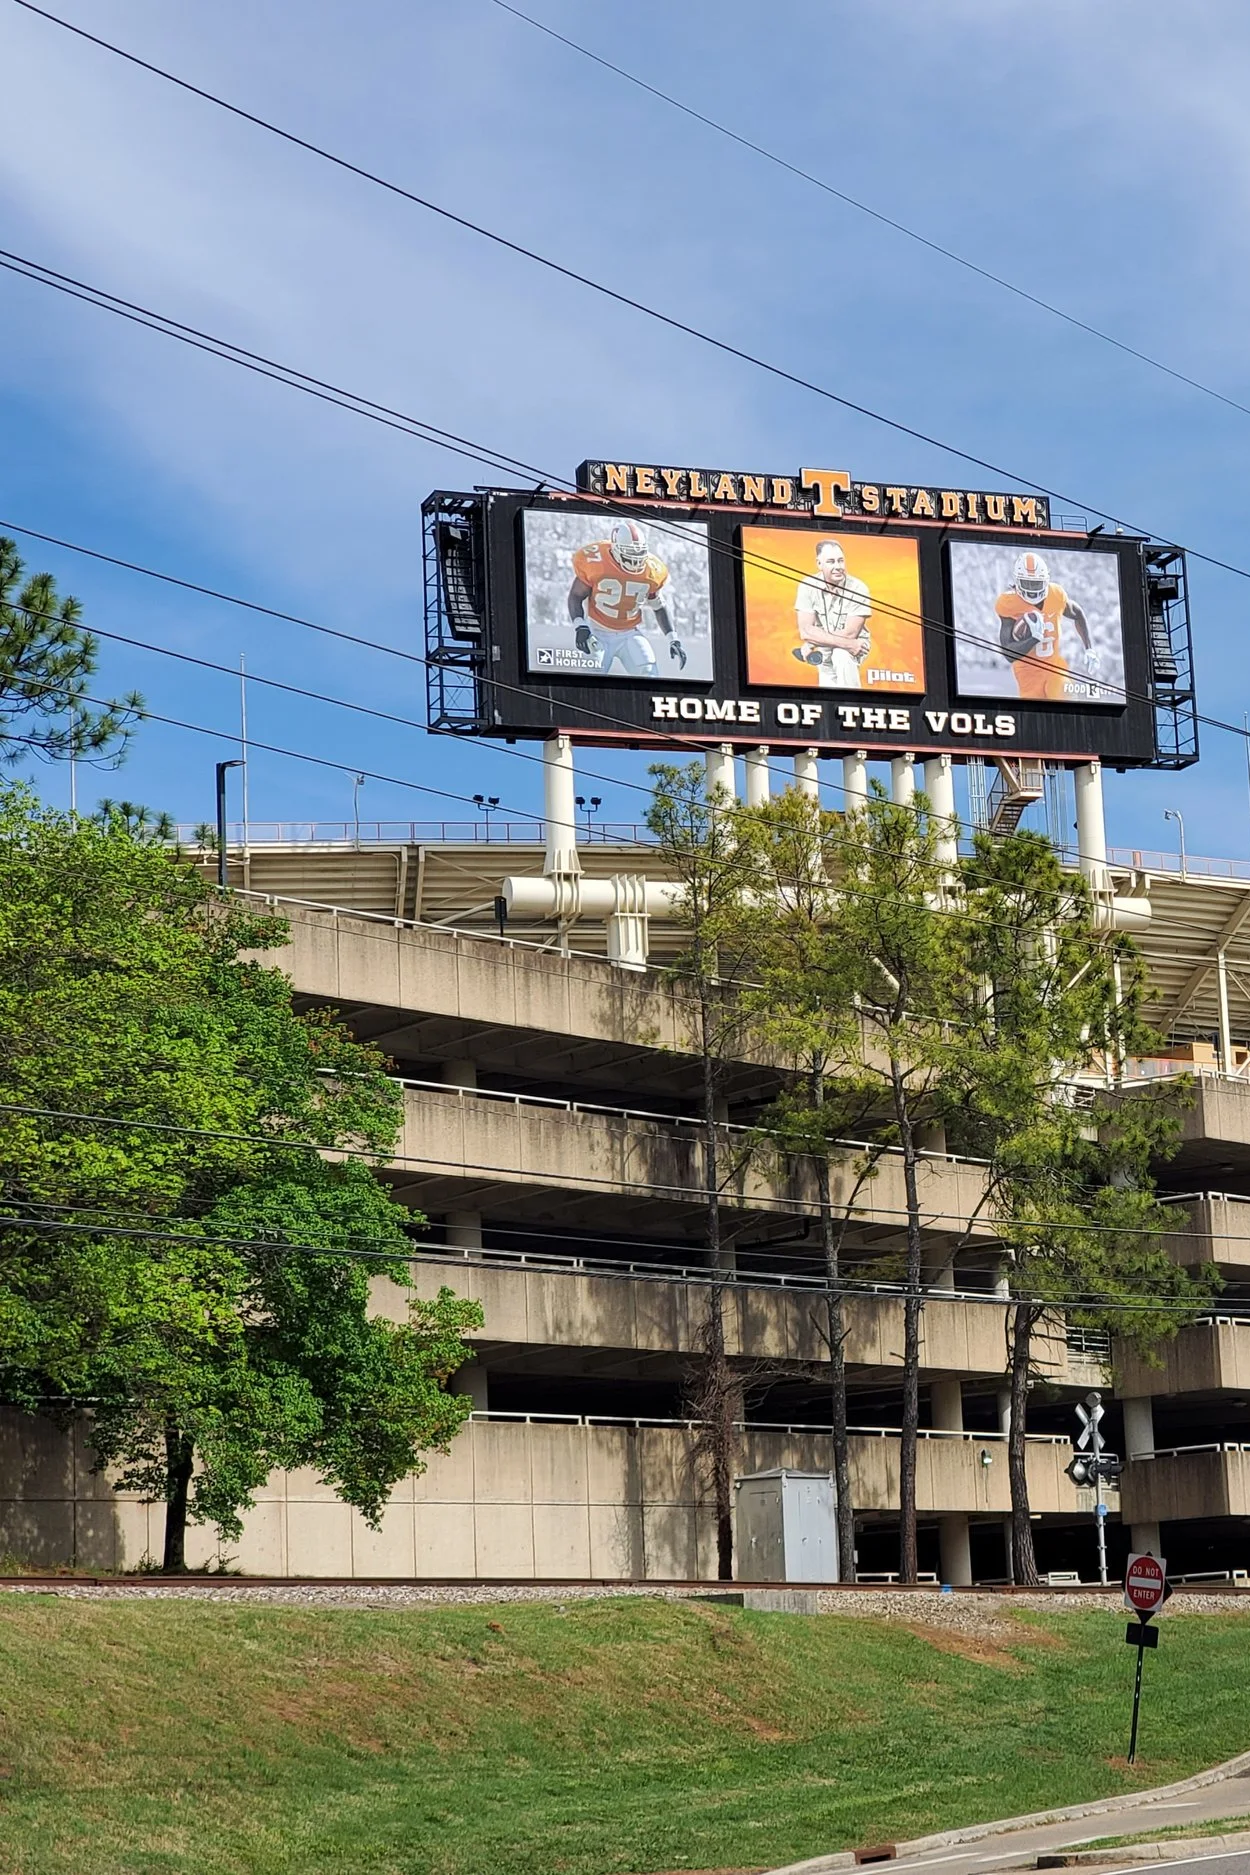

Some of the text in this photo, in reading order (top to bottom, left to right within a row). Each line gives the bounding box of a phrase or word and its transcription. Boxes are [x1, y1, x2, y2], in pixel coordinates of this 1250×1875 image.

[605, 464, 1037, 523] NEYLAND T STADIUM
[594, 578, 651, 620] 27
[555, 649, 584, 660] FIRST
[555, 658, 603, 669] HORIZON
[1063, 684, 1086, 694] FOOD
[651, 696, 1016, 736] HOME OF THE VOLS
[1132, 1565, 1160, 1577] DO NOT
[1133, 1589, 1155, 1600] ENTER
